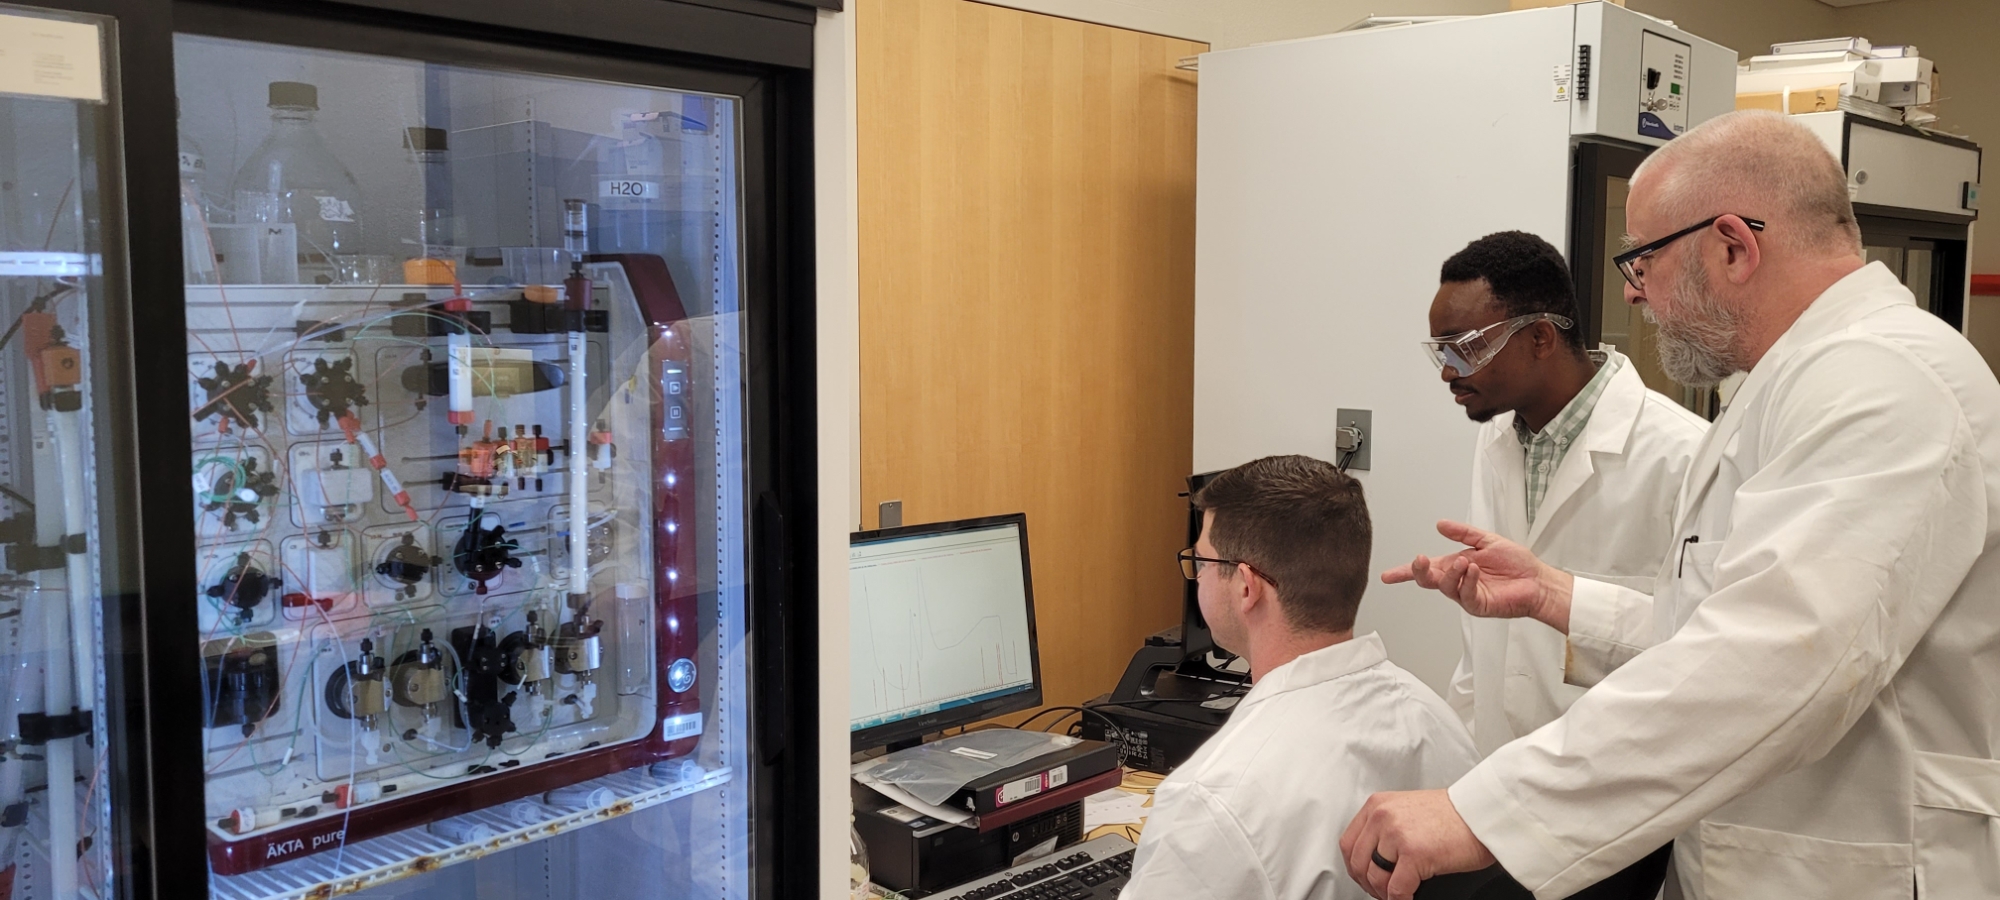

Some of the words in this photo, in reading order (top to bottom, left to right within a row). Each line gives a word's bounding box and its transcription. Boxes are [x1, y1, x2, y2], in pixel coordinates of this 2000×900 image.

[610, 182, 643, 196] H2O
[266, 838, 305, 860] ÄKTA
[312, 830, 345, 850] pure
